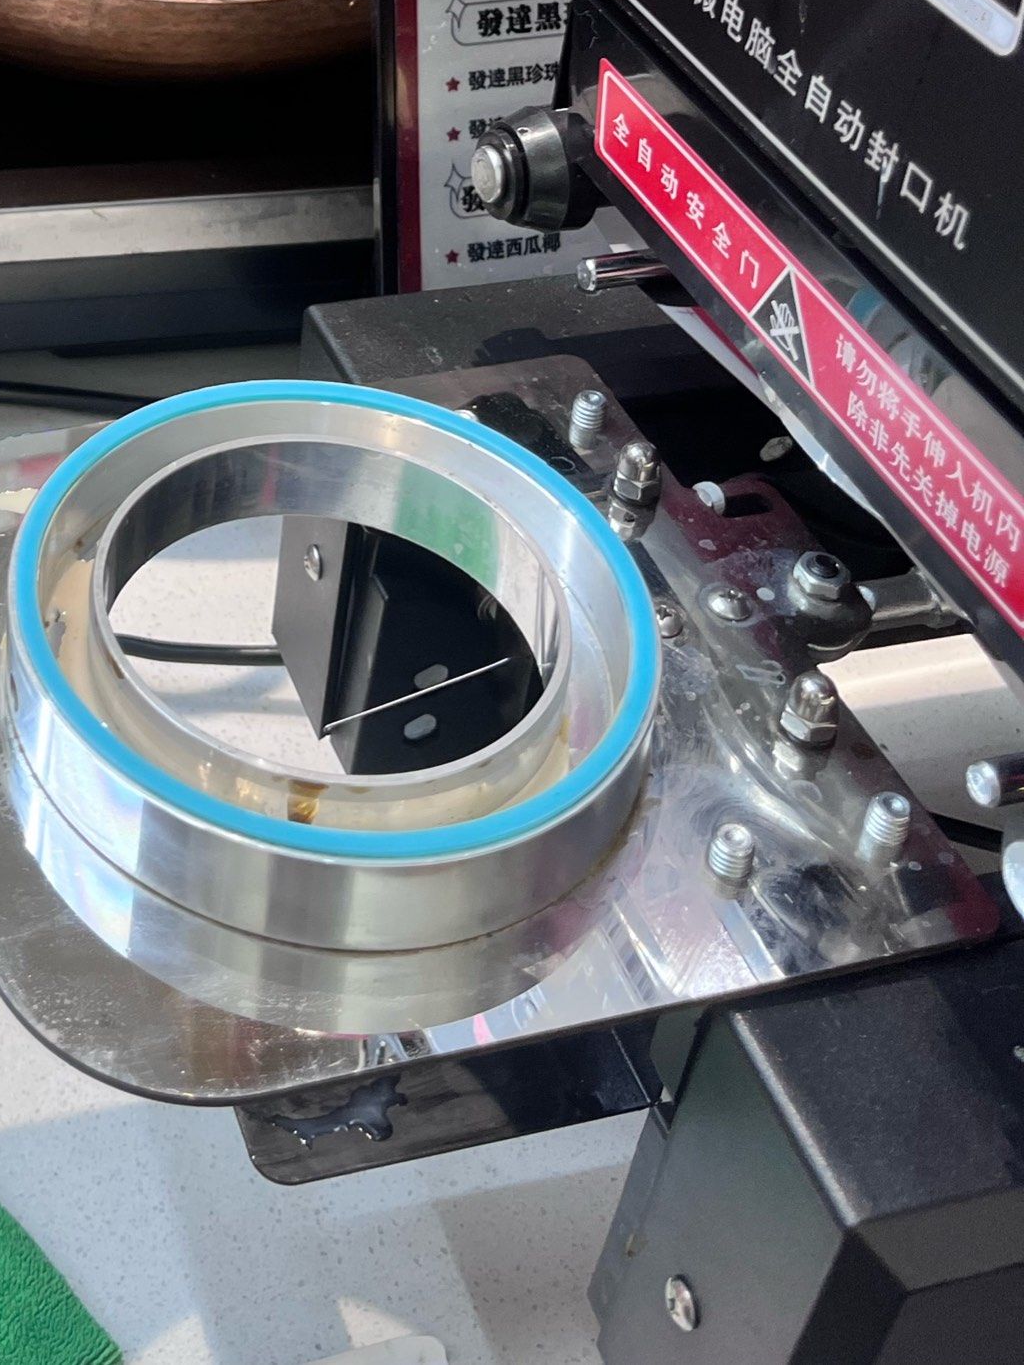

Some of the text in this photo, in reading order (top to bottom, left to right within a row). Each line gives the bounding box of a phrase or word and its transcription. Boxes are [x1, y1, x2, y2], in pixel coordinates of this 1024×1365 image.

[477, 1, 572, 37] 發達黑
[612, 112, 760, 289] 全自动安全门
[835, 334, 1021, 553] 请勿将手伸入机内
[846, 391, 1011, 588] 除非先关掉电源
